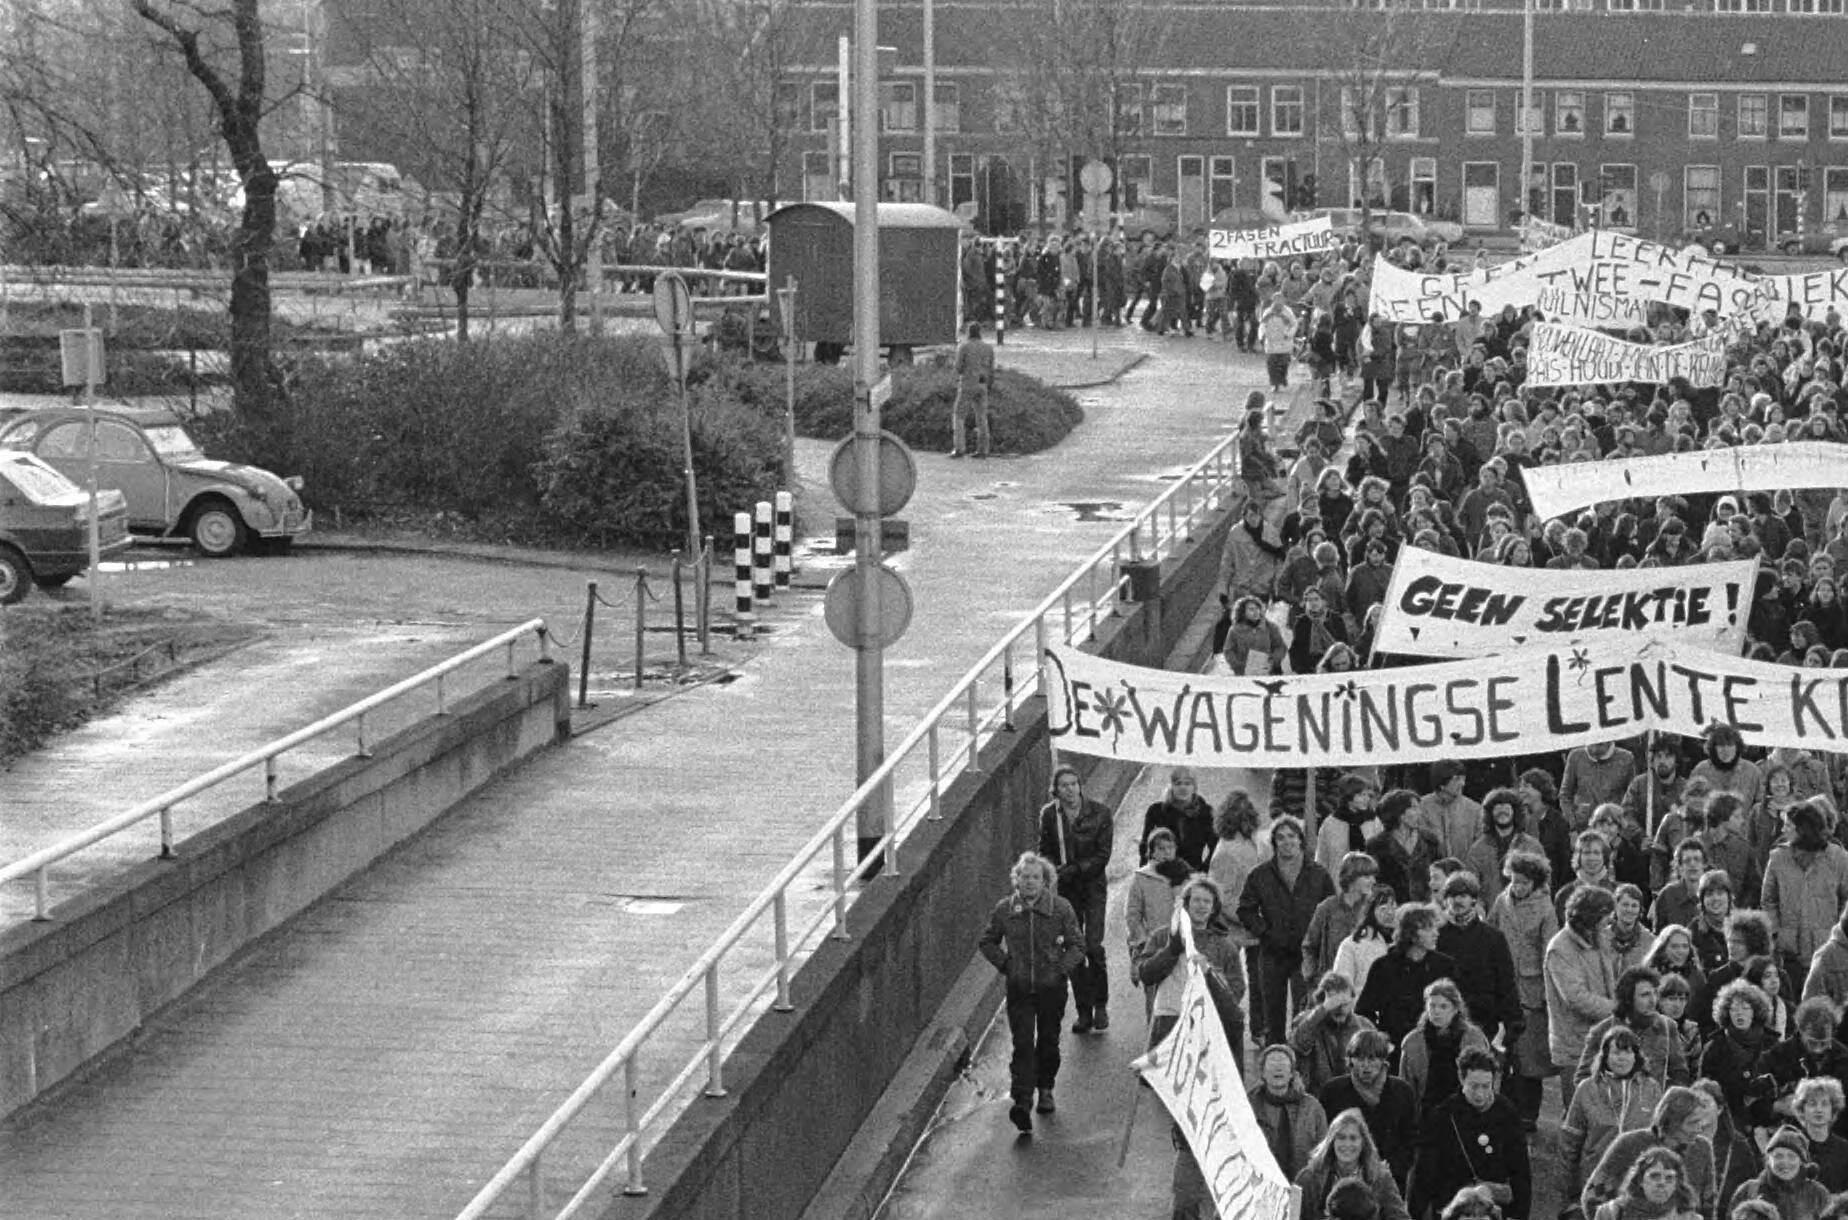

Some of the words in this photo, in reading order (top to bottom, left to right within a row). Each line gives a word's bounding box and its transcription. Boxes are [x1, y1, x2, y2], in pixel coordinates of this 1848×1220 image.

[1400, 574, 1525, 626] GEEN
[1046, 648, 1101, 738] DE
[1545, 654, 1765, 735] LENTE
